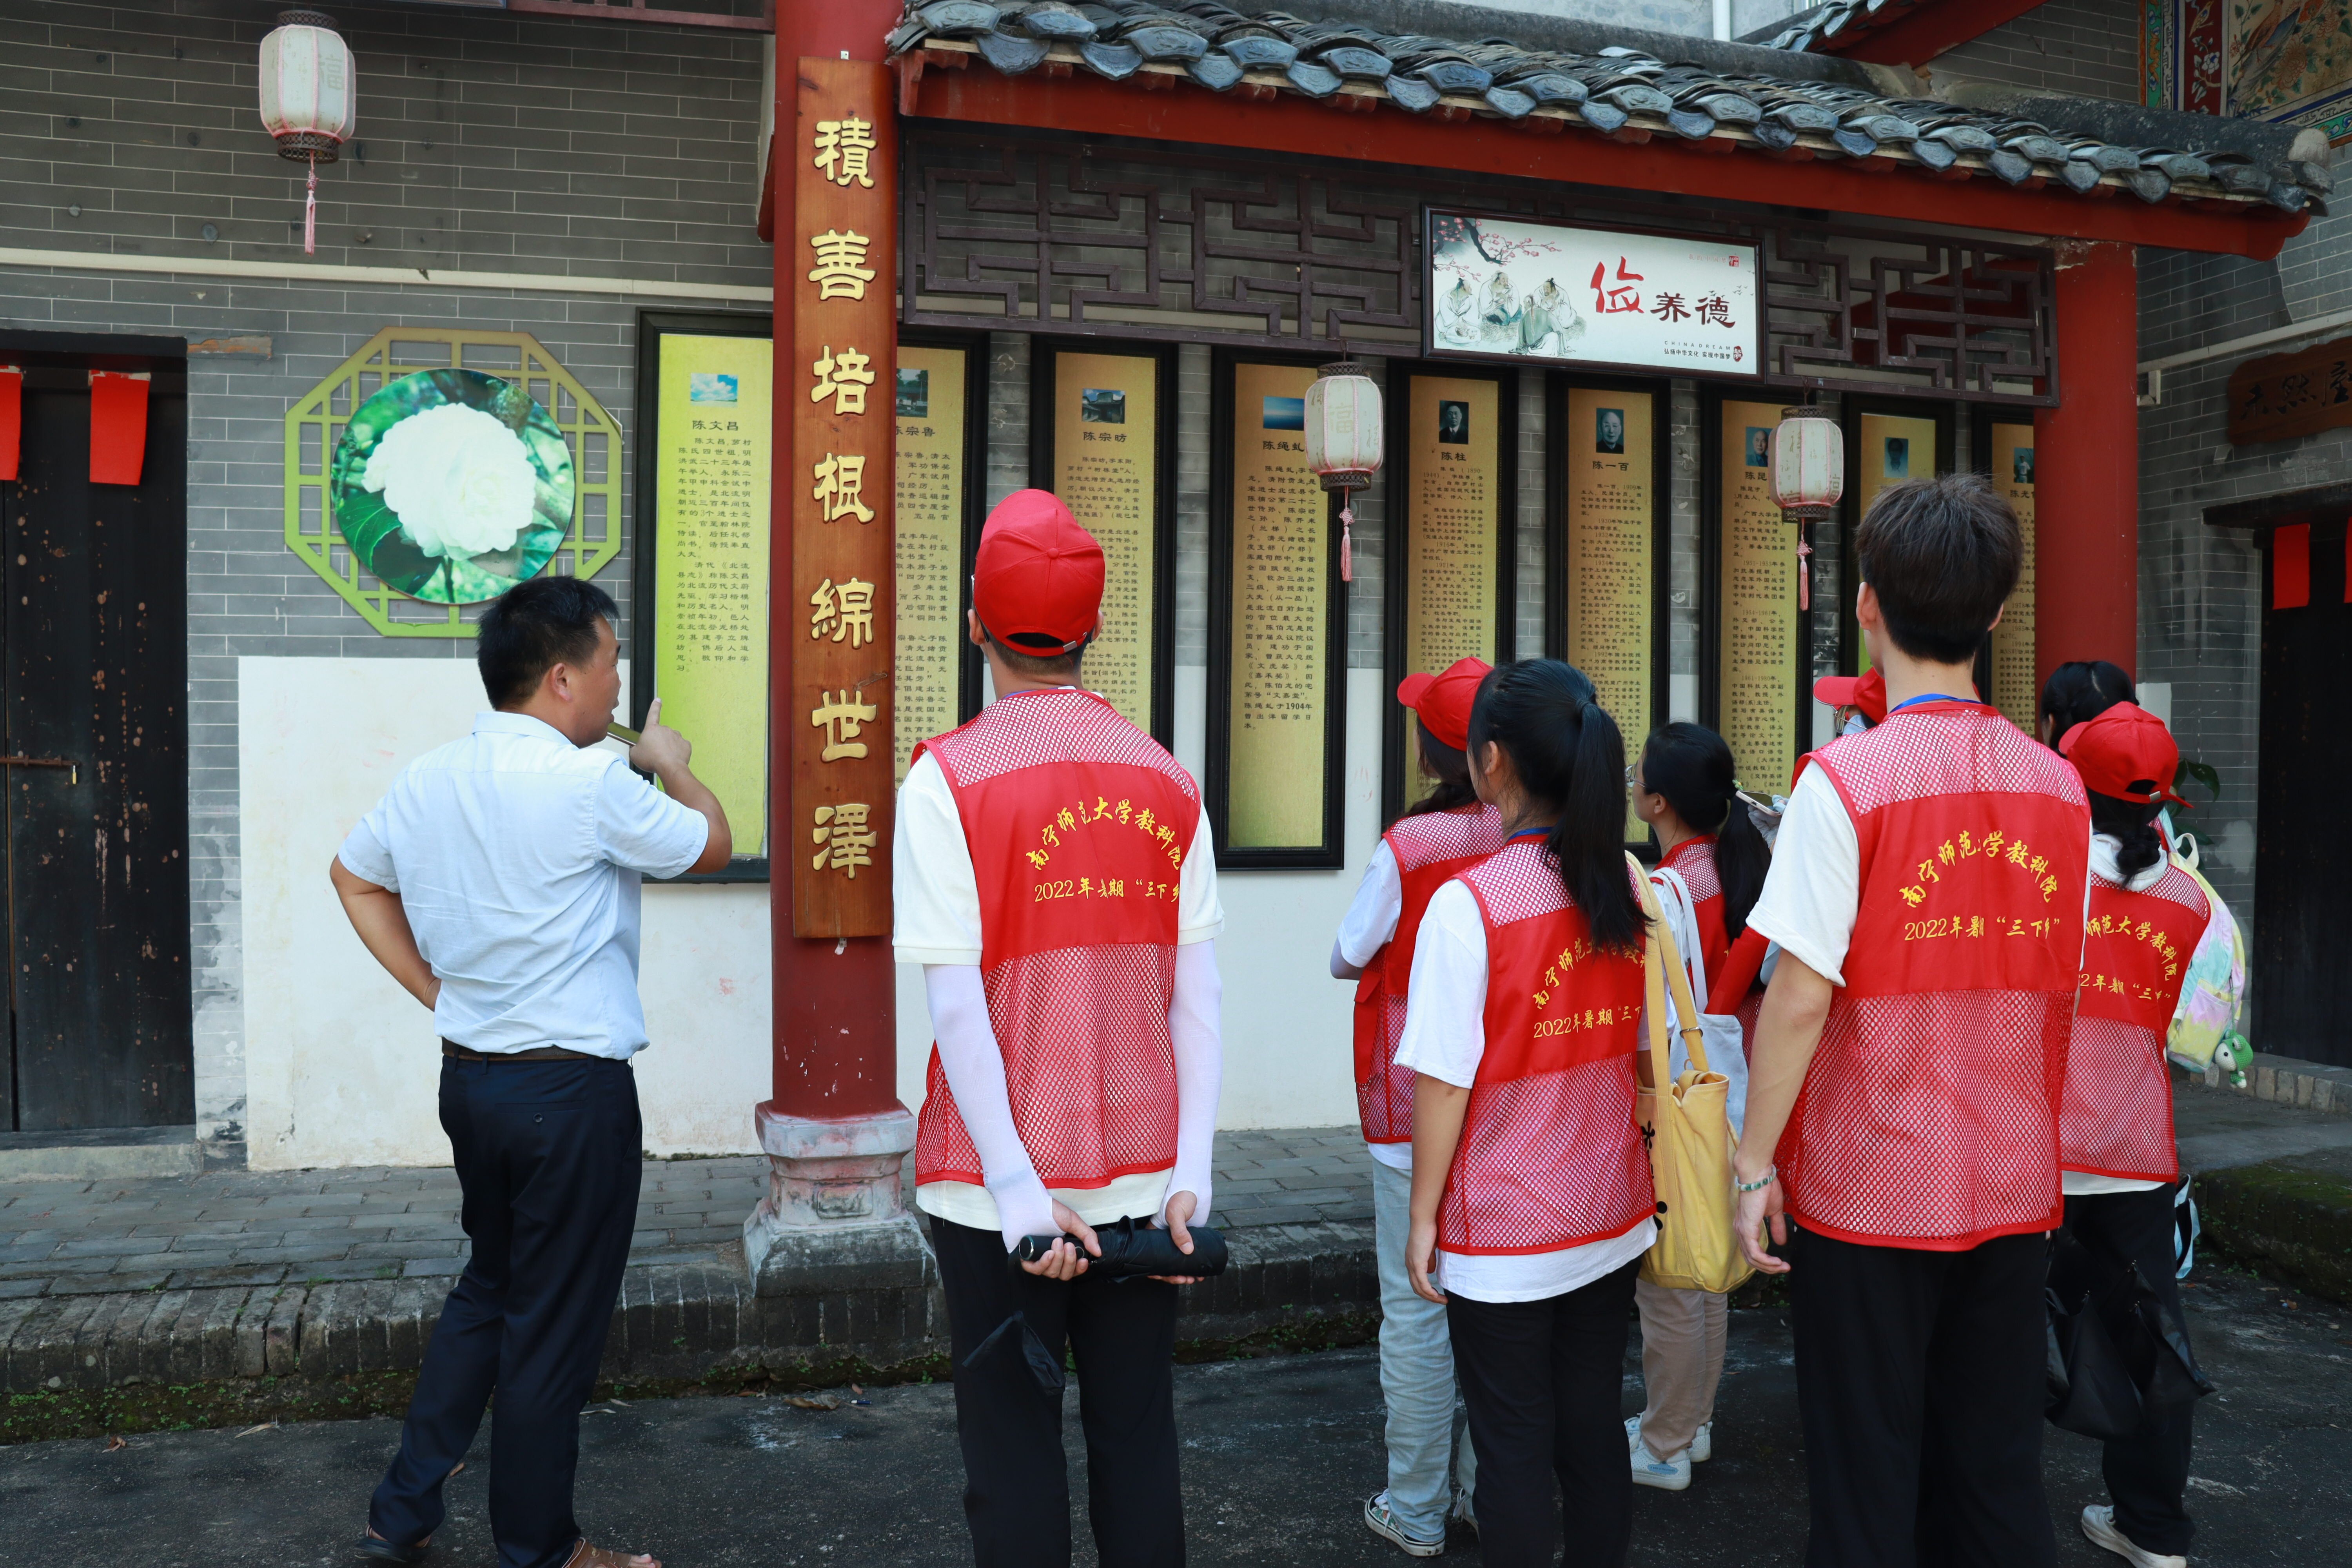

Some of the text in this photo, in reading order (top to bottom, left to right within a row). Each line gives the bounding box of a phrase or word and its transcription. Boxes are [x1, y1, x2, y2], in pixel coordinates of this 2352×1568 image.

[1650, 292, 1736, 328] 养德
[1664, 348, 1699, 358] 弘扬中华文化
[1702, 351, 1731, 360] 实现中国梦
[692, 420, 739, 431] 陈文昌
[1082, 432, 1127, 443] 陈宗昉
[1441, 451, 1467, 461] 陈柱
[1592, 460, 1629, 472] 陈一百
